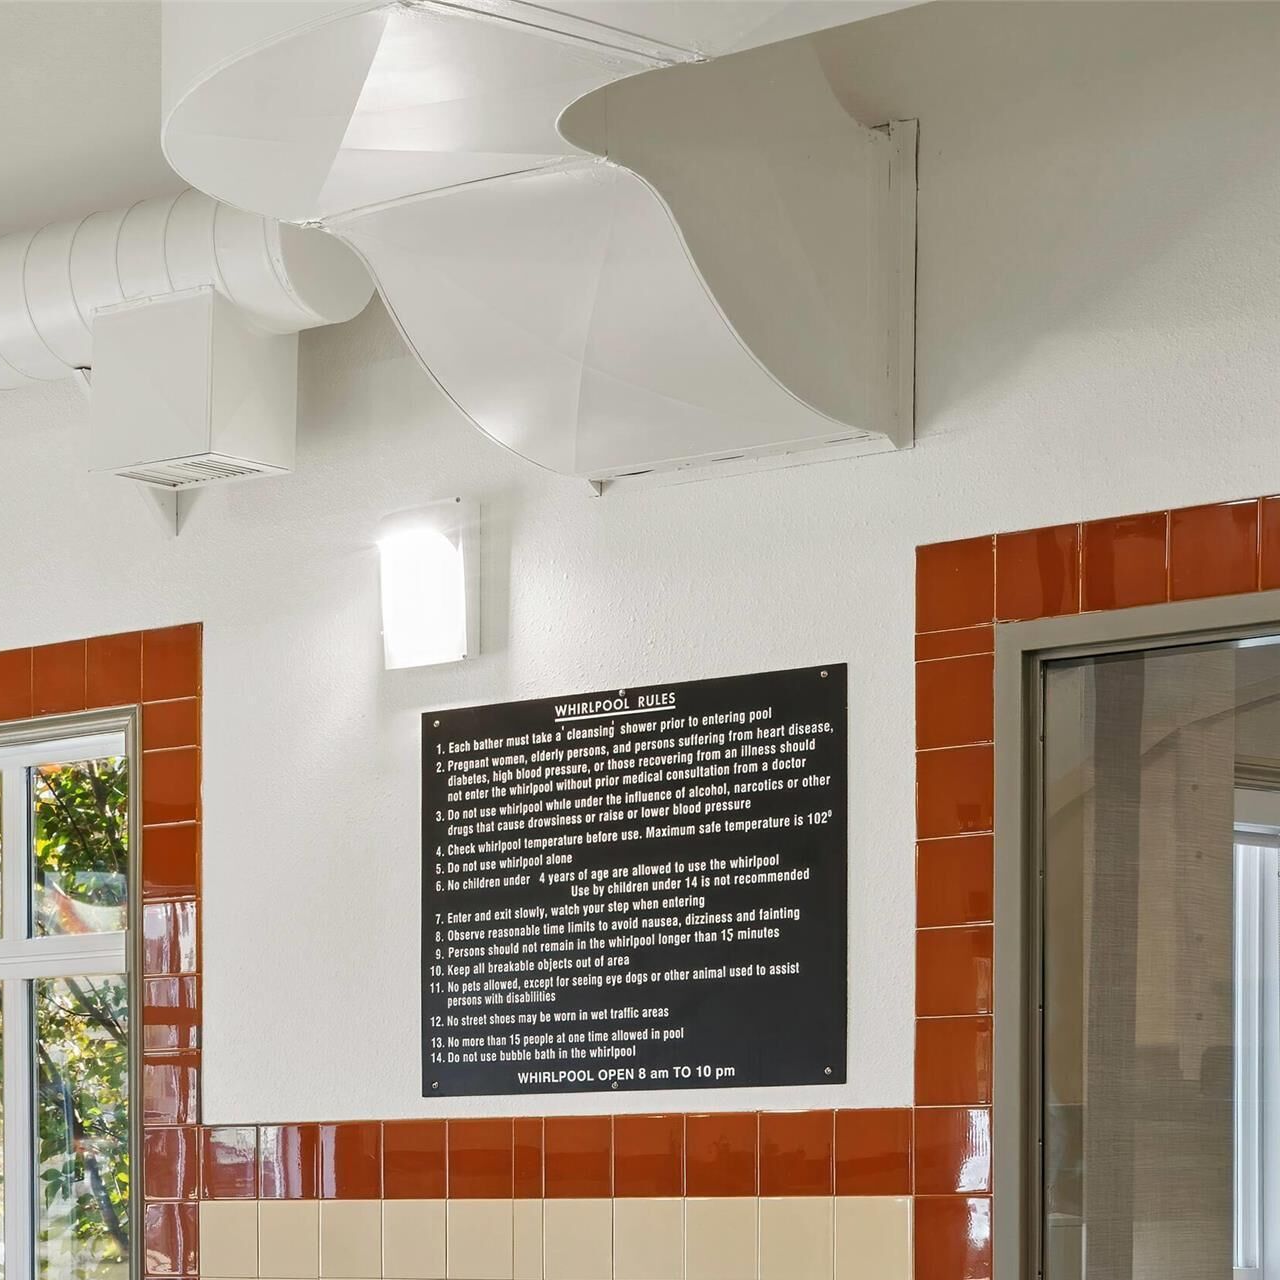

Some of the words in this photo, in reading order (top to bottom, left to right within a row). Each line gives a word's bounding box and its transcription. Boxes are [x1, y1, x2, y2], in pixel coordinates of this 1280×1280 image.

[554, 697, 630, 717] WHIRLPOOL
[638, 691, 675, 708] RULES
[436, 761, 445, 773] 2.
[447, 756, 489, 772] Pregnant
[491, 754, 528, 767] women,
[530, 748, 564, 763] elderly
[566, 745, 609, 761] persons,
[612, 740, 631, 754] and
[634, 738, 675, 754] persons
[678, 731, 725, 747] suffering
[728, 729, 753, 742] from
[756, 724, 785, 739] heart
[788, 722, 833, 736] disease,
[447, 773, 490, 787] diabetes,
[492, 769, 513, 783] high
[515, 765, 542, 780] blood
[544, 763, 590, 779] pressure,
[593, 761, 604, 772] or
[607, 758, 635, 770] those
[638, 751, 693, 767] recovering
[696, 749, 721, 761] from
[724, 748, 737, 759] an
[741, 744, 776, 757] illness
[779, 738, 815, 753] should
[435, 810, 445, 822] 3.
[447, 809, 460, 821] Do
[462, 807, 477, 819] not
[479, 807, 497, 817] use
[499, 799, 543, 816] whirlpool
[545, 798, 572, 811] while
[574, 795, 603, 808] under
[605, 793, 622, 805] the
[624, 790, 672, 804] influence
[675, 786, 685, 799] of
[688, 782, 730, 798] alcohol,
[734, 778, 784, 793] narcotics
[787, 778, 798, 789] or
[802, 774, 831, 787] other
[447, 824, 474, 837] drugs
[476, 820, 494, 833] that
[497, 819, 525, 831] cause
[527, 813, 582, 829] drowsiness
[585, 813, 596, 823] or
[598, 809, 624, 822] raise
[627, 809, 638, 819] or
[641, 806, 670, 818] lower
[672, 801, 701, 815] blood
[704, 799, 751, 815] pressure
[435, 845, 445, 857] 4.
[447, 842, 476, 856] Check
[477, 838, 521, 854] whirlpool
[523, 834, 583, 850] temperature
[586, 830, 618, 844] before
[621, 830, 642, 841] use.
[645, 824, 695, 838] Maximum
[698, 820, 721, 834] safe
[724, 816, 790, 833] temperature
[793, 813, 804, 826] is
[435, 880, 445, 892] 6.
[447, 879, 460, 891] No
[462, 876, 500, 890] children
[503, 873, 530, 886] under
[539, 872, 545, 883] 4
[547, 871, 575, 885] years
[578, 868, 588, 881] of
[590, 869, 609, 882] age
[611, 867, 629, 878] are
[631, 861, 671, 876] allowed
[674, 861, 685, 873] to
[687, 861, 706, 872] use
[709, 858, 726, 870] the
[729, 853, 779, 869] whirlpool
[570, 884, 590, 897] Use
[592, 883, 605, 897] by
[607, 880, 648, 894] children
[651, 877, 682, 891] under
[684, 876, 697, 888] 14
[701, 875, 710, 887] is
[714, 873, 731, 886] not
[733, 867, 810, 885] recommended
[435, 913, 444, 925] 7.
[447, 912, 472, 924] Enter
[474, 909, 491, 922] and
[494, 908, 512, 920] exit
[514, 905, 548, 920] slowly,
[550, 903, 580, 916] watch
[582, 903, 605, 917] your
[607, 900, 629, 914] step
[632, 898, 659, 910] when
[662, 894, 705, 908] entering
[435, 948, 444, 960] 9.
[448, 946, 485, 958] Persons
[487, 942, 519, 956] should
[522, 941, 538, 953] not
[540, 939, 574, 952] remain
[577, 938, 586, 950] in
[589, 937, 605, 949] the
[608, 933, 655, 949] whirlpool
[658, 932, 691, 946] longer
[693, 930, 717, 943] than
[720, 927, 734, 942] 15
[737, 926, 780, 940] minutes
[429, 964, 444, 976] 10.
[447, 964, 470, 977] Keep
[473, 962, 485, 974] all
[487, 959, 535, 973] breakable
[537, 957, 573, 972] objects
[575, 956, 591, 968] out
[594, 955, 604, 967] of
[607, 955, 630, 966] area
[430, 1015, 444, 1027] 12.
[446, 1015, 459, 1026] No
[460, 1014, 487, 1026] street
[489, 1013, 516, 1025] shoes
[518, 1013, 537, 1025] may
[539, 1010, 551, 1022] be
[553, 1011, 576, 1022] worn
[578, 1009, 588, 1021] in
[590, 1008, 608, 1020] wet
[610, 1006, 639, 1019] traffic
[641, 1007, 669, 1018] areas
[431, 1036, 445, 1048] 13.
[447, 1036, 460, 1048] No
[461, 1037, 485, 1047] more
[486, 1034, 506, 1046] than
[509, 1033, 520, 1045] 15
[523, 1032, 554, 1047] people
[556, 1032, 566, 1043] at
[568, 1033, 585, 1043] one
[587, 1030, 609, 1042] time
[611, 1028, 648, 1041] allowed
[651, 1027, 660, 1039] in
[663, 1026, 684, 1042] pool
[430, 1052, 445, 1063] 14.
[447, 1051, 460, 1063] Do
[462, 1051, 478, 1062] not
[480, 1052, 497, 1062] use
[499, 1049, 531, 1061] bubble
[534, 1047, 555, 1060] bath
[558, 1047, 568, 1059] in
[570, 1047, 586, 1059] the
[588, 1044, 636, 1059] whirlpool
[517, 1069, 594, 1084] WHIRLPOOL
[597, 1068, 634, 1081] OPEN
[638, 1067, 646, 1079] 8
[650, 1069, 669, 1079] am
[672, 1065, 691, 1078] TO
[695, 1064, 711, 1077] 10
[715, 1066, 735, 1080] pm
